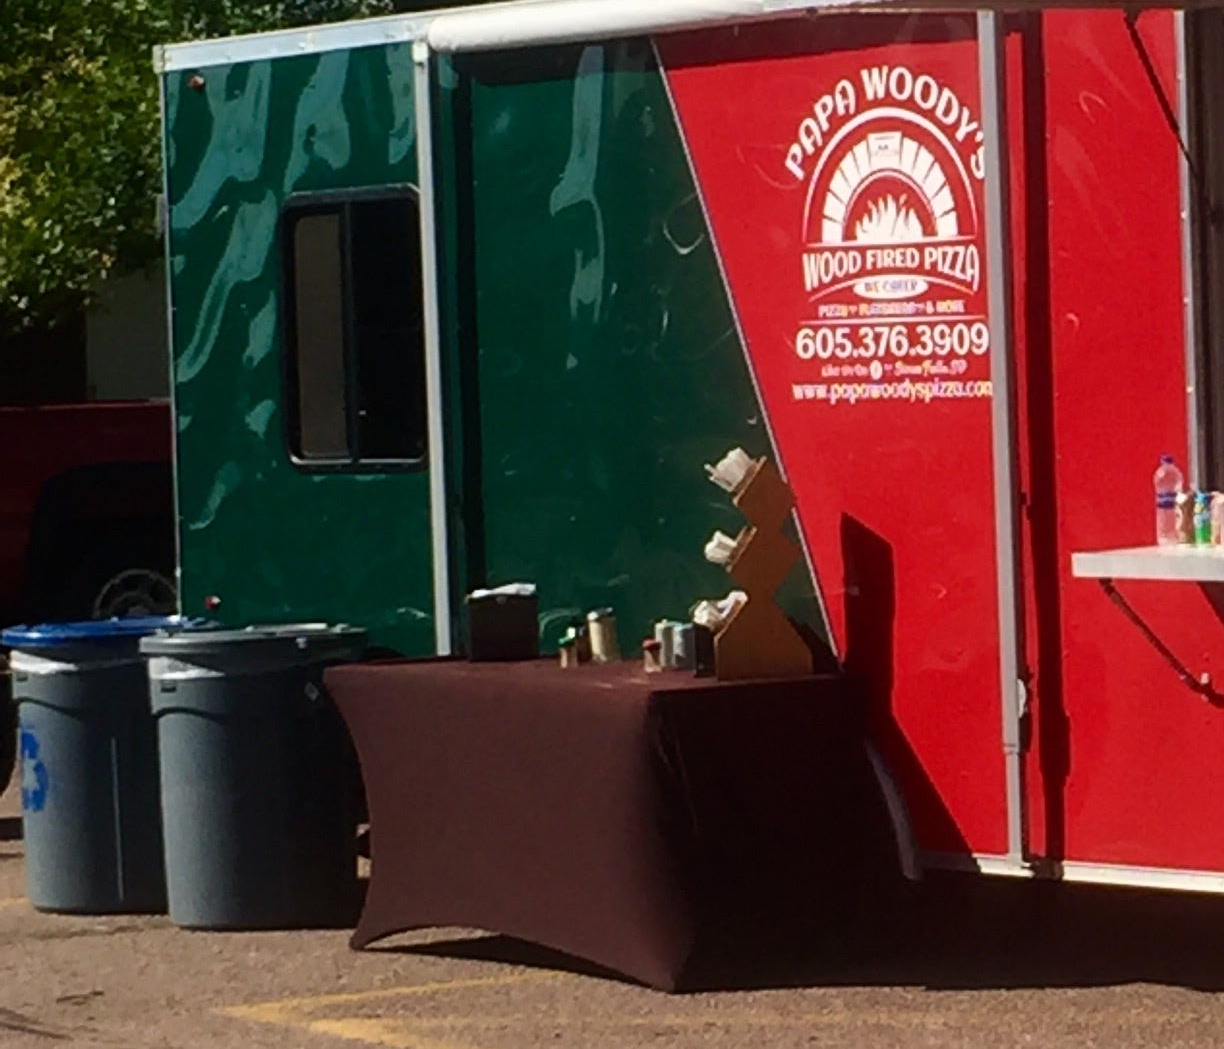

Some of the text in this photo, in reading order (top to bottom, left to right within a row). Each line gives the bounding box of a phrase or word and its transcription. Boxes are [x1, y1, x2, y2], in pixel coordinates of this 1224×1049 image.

[784, 79, 856, 181] PAPA
[802, 244, 980, 293] WOOD FIRED PIZZA
[796, 323, 989, 360] 605.376.3909
